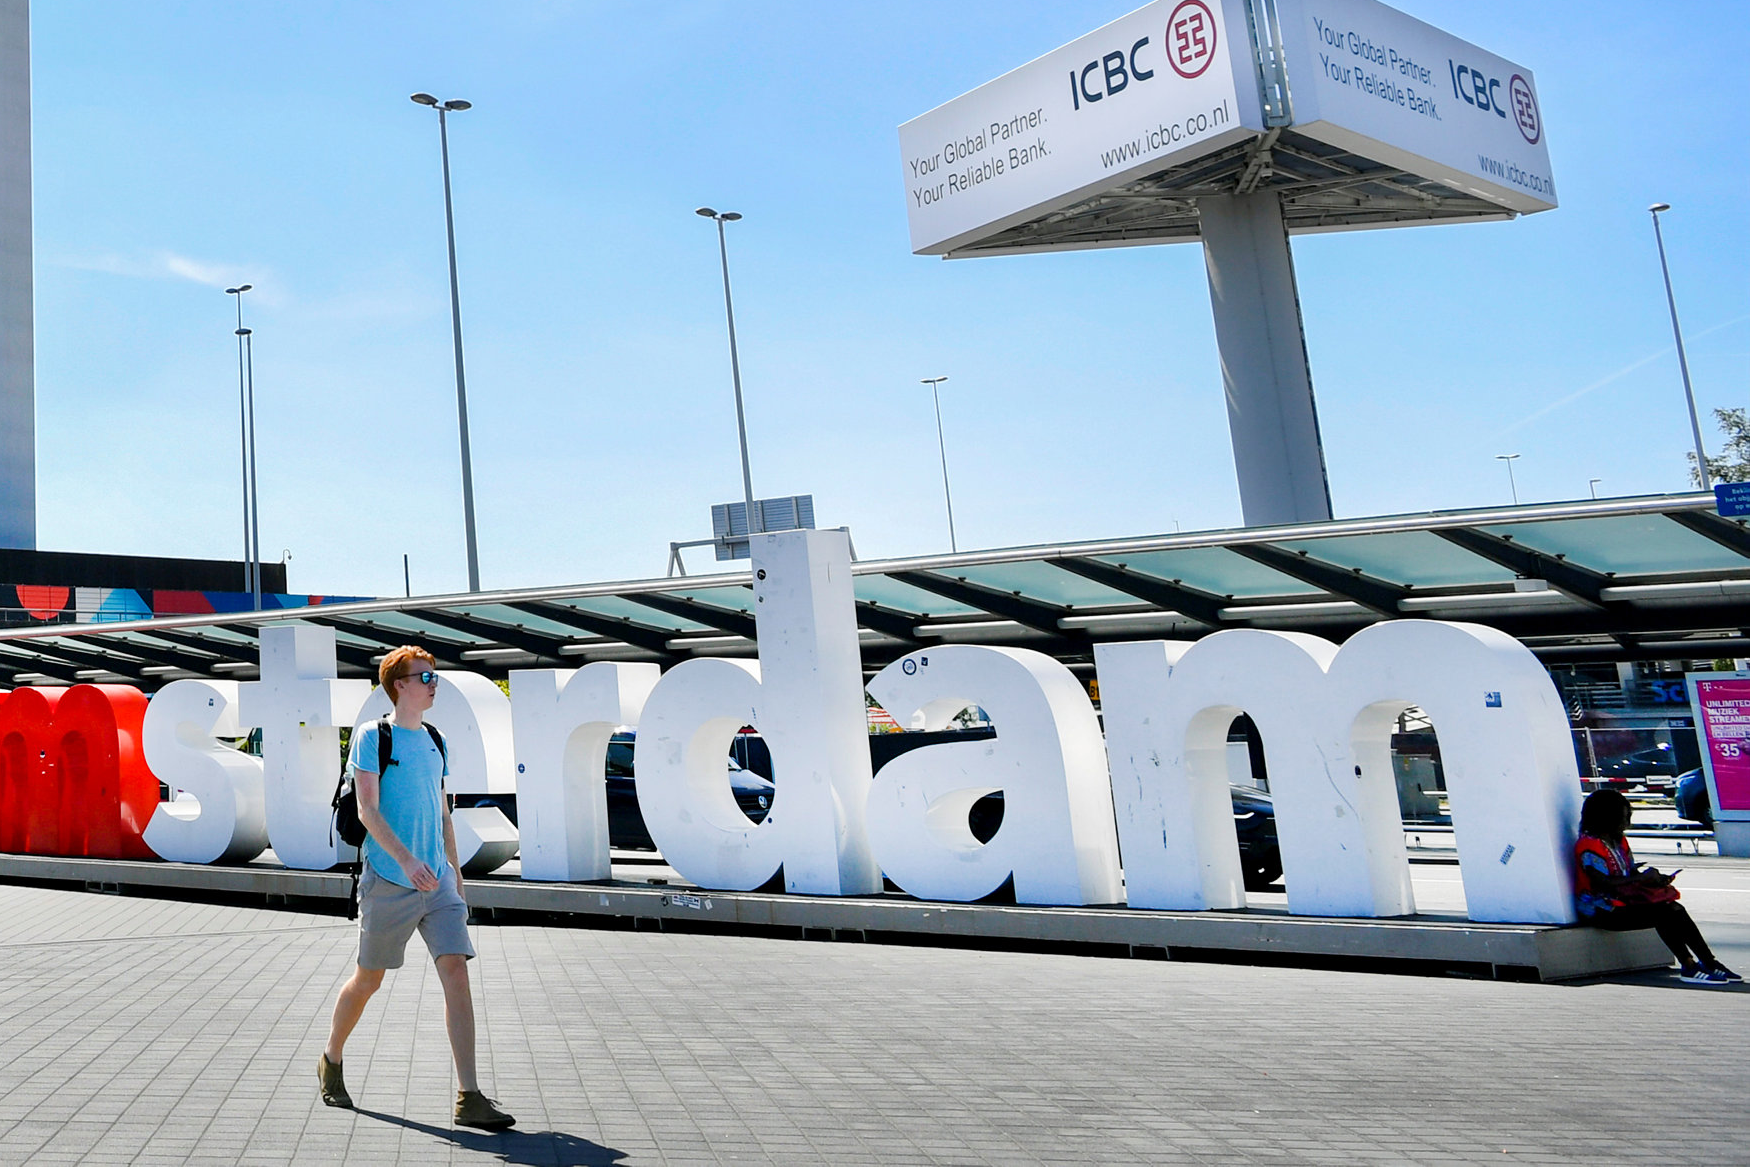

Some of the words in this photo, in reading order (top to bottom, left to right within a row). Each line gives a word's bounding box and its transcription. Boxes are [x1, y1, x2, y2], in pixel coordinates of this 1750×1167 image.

[1069, 36, 1154, 111] ICBC
[1313, 16, 1345, 50] Your
[1348, 31, 1388, 68] Global
[1389, 48, 1437, 88] Partner.
[1319, 52, 1351, 86] Your
[1354, 66, 1406, 107] Reliable
[1407, 87, 1442, 122] Bank.
[1448, 59, 1506, 119] ICBC
[910, 153, 940, 179] Your
[944, 129, 987, 164] Global
[990, 108, 1048, 145] Partner.
[1101, 99, 1230, 169] www.icbc.co.nl
[913, 183, 944, 208] Your
[948, 157, 1005, 195] Reliable
[1008, 137, 1052, 170] Bank.
[1478, 154, 1554, 196] www.icbc.co.nl
[1707, 707, 1740, 715] MUZIEK
